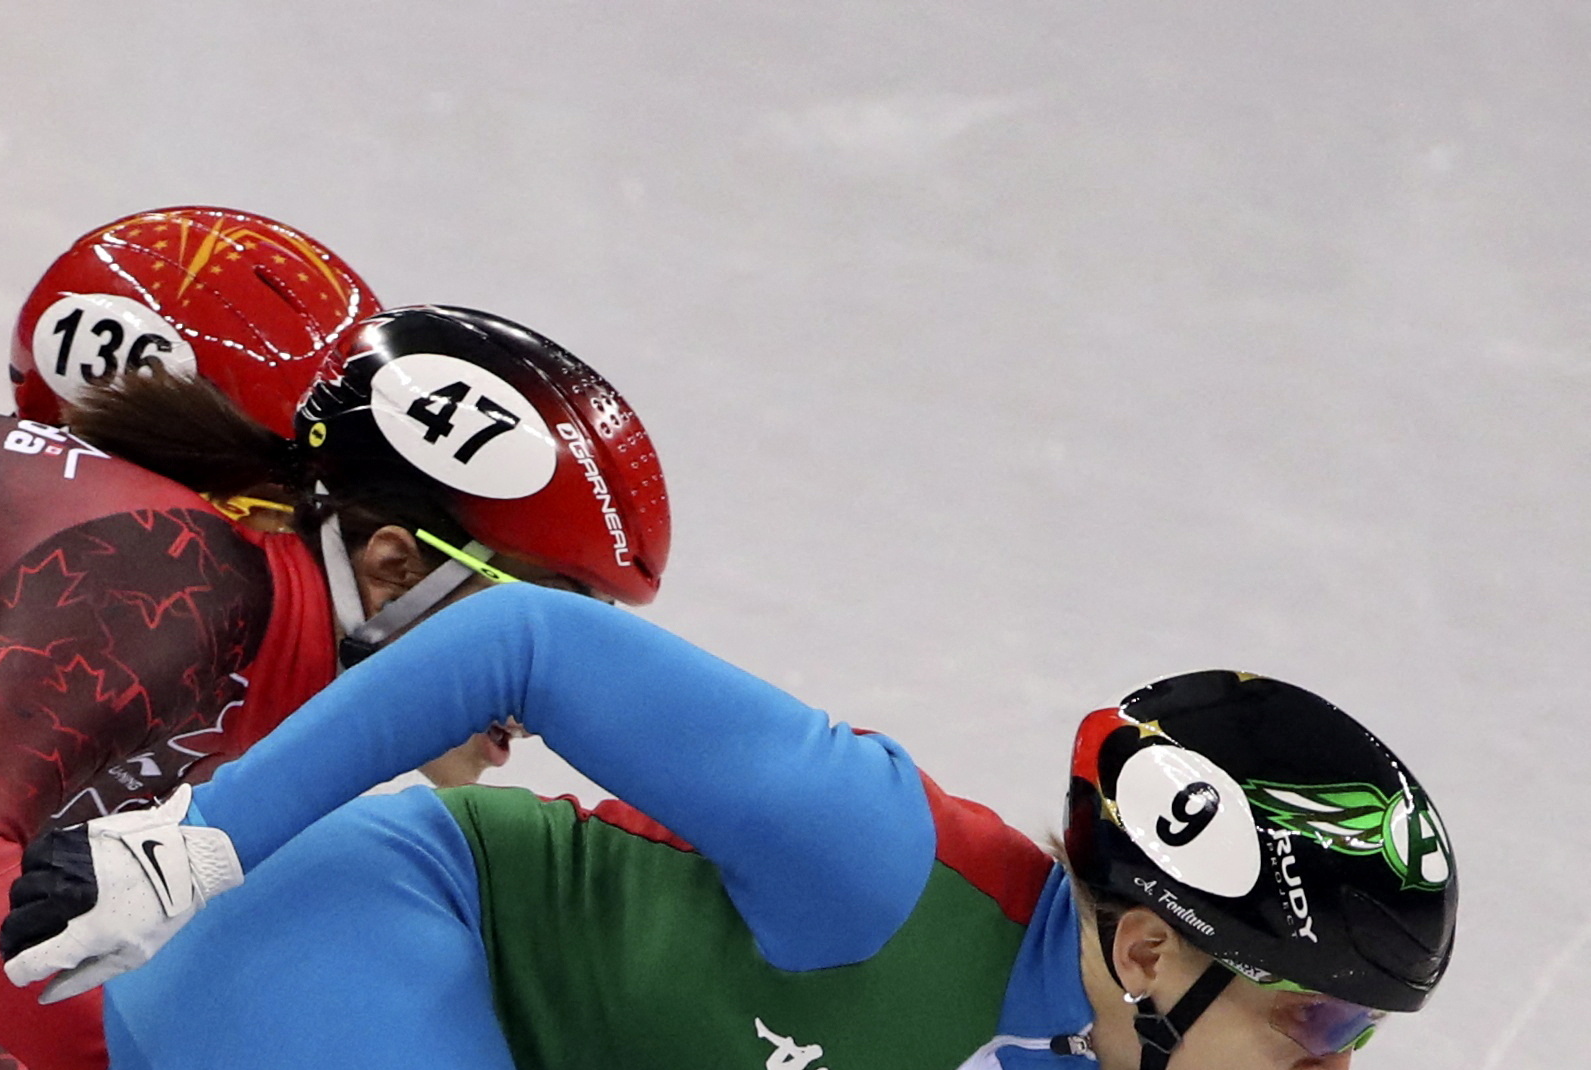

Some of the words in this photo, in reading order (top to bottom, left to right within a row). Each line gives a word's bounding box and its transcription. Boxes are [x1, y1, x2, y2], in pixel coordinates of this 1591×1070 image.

[407, 381, 521, 465] 47
[1156, 781, 1220, 847] 9
[1158, 889, 1216, 937] Fontana
[1272, 829, 1319, 944] RUDY
